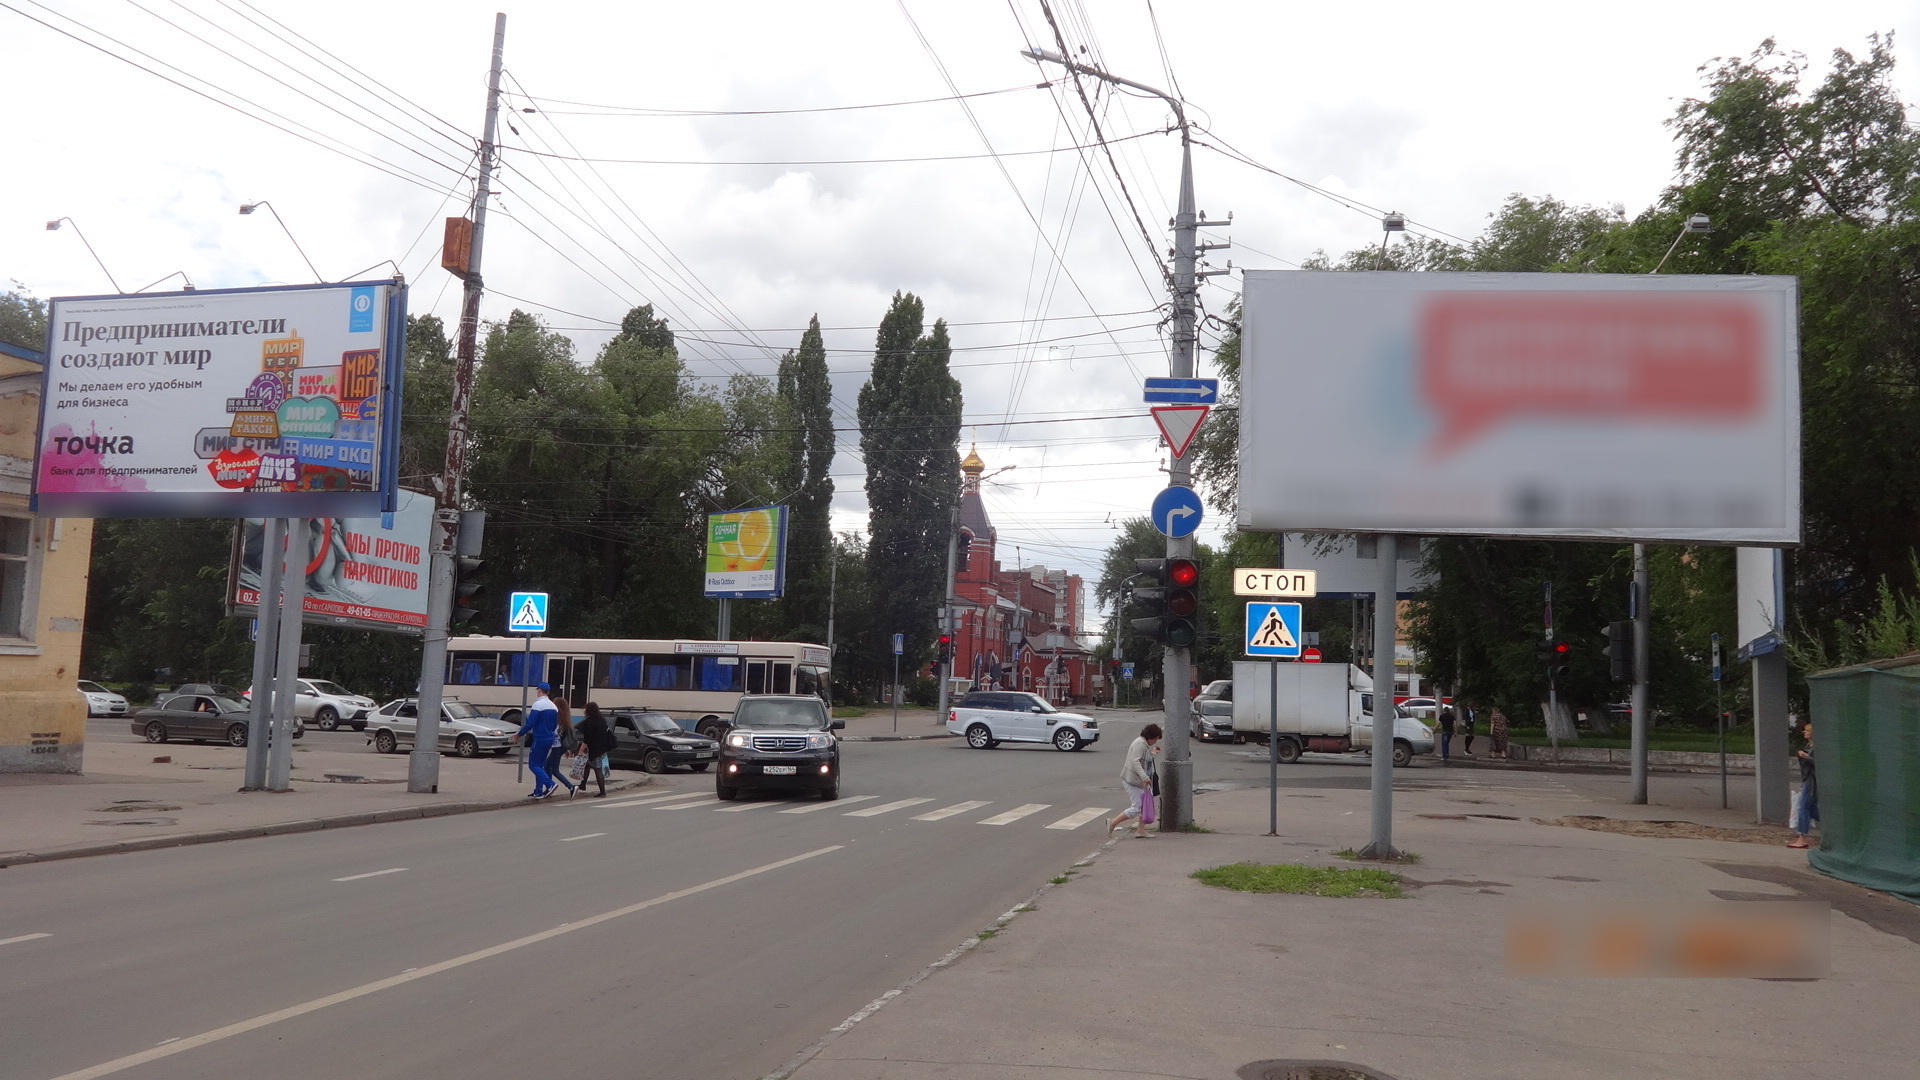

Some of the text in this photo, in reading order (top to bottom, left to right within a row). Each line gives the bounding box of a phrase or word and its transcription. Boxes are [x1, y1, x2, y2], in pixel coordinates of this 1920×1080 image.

[62, 318, 286, 347] Предприниматели
[265, 342, 300, 354] МИР
[60, 349, 212, 370] создают мир
[266, 357, 298, 366] ТЕЛ
[58, 379, 202, 393] Мы делаем его удобным
[299, 375, 323, 385] МИР
[298, 385, 338, 395] ЗВУКА
[57, 396, 129, 409] для бизнеса
[243, 415, 266, 424] МИР
[286, 406, 327, 421] МИР
[235, 424, 274, 434] ТАКСИ
[279, 421, 332, 433] ОПТИКИ
[53, 435, 134, 455] точка
[203, 436, 238, 451] МИР
[302, 444, 334, 460] МИР
[261, 456, 295, 468] МИР
[50, 464, 198, 476] банк для предпринимателей
[258, 466, 297, 480] ШУБ
[346, 532, 420, 565] МЫ ПРОТИВ
[343, 560, 418, 590] НАРКОТИКОВ
[1245, 574, 1306, 591] СТОП
[346, 605, 371, 616] 49-61-05
